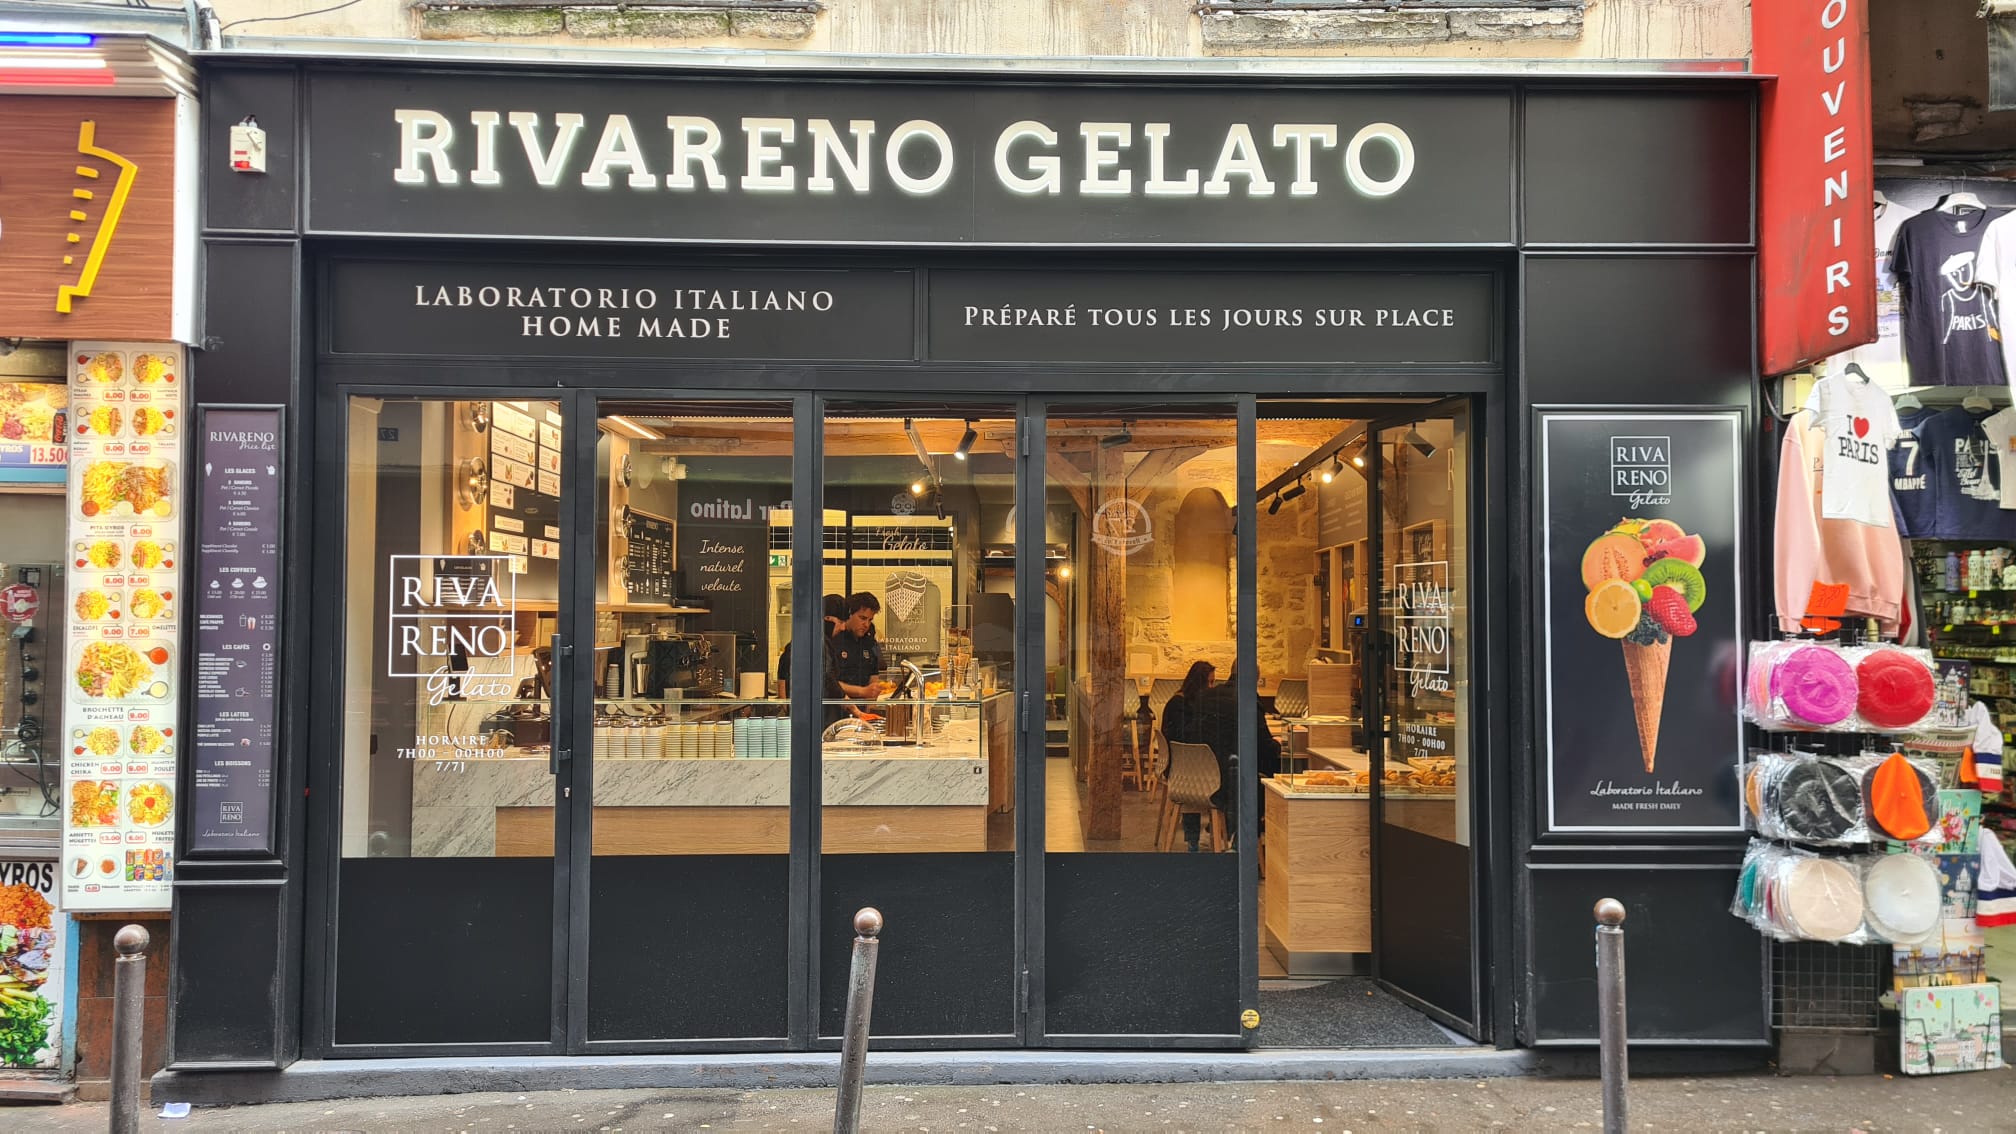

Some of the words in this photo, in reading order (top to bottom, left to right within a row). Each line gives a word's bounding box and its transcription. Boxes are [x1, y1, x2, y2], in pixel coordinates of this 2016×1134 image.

[393, 108, 954, 194] RIVARENO
[994, 119, 1416, 197] GELATO
[415, 285, 658, 310] LABORATORIO
[674, 288, 834, 312] ITALIANO
[521, 315, 622, 338] HOME
[638, 318, 732, 340] MADE
[1951, 313, 1988, 331] PARIS
[1846, 414, 1853, 436] I
[210, 431, 275, 442] RIVARENO
[1616, 446, 1666, 462] RIVA
[1837, 436, 1879, 465] PARIS
[1900, 440, 1920, 476] 7
[1616, 469, 1667, 486] RENO
[1629, 489, 1671, 510] Gelato
[401, 576, 505, 607] RIVA
[1399, 581, 1443, 609] RIVA
[400, 625, 507, 656] RENO
[1399, 625, 1446, 655] RENO
[426, 665, 512, 706] Gelato
[1409, 661, 1449, 698] Gelato
[416, 735, 487, 745] HORAIRE
[1405, 722, 1437, 737] HORAIRE
[1397, 733, 1416, 745] 7H00
[1422, 737, 1446, 750] 00H00
[396, 748, 436, 758] 7H00
[455, 748, 505, 758] 00H00
[435, 761, 465, 773] 7/7J
[1590, 780, 1653, 797] Laboratorio
[1655, 780, 1703, 796] Italiano
